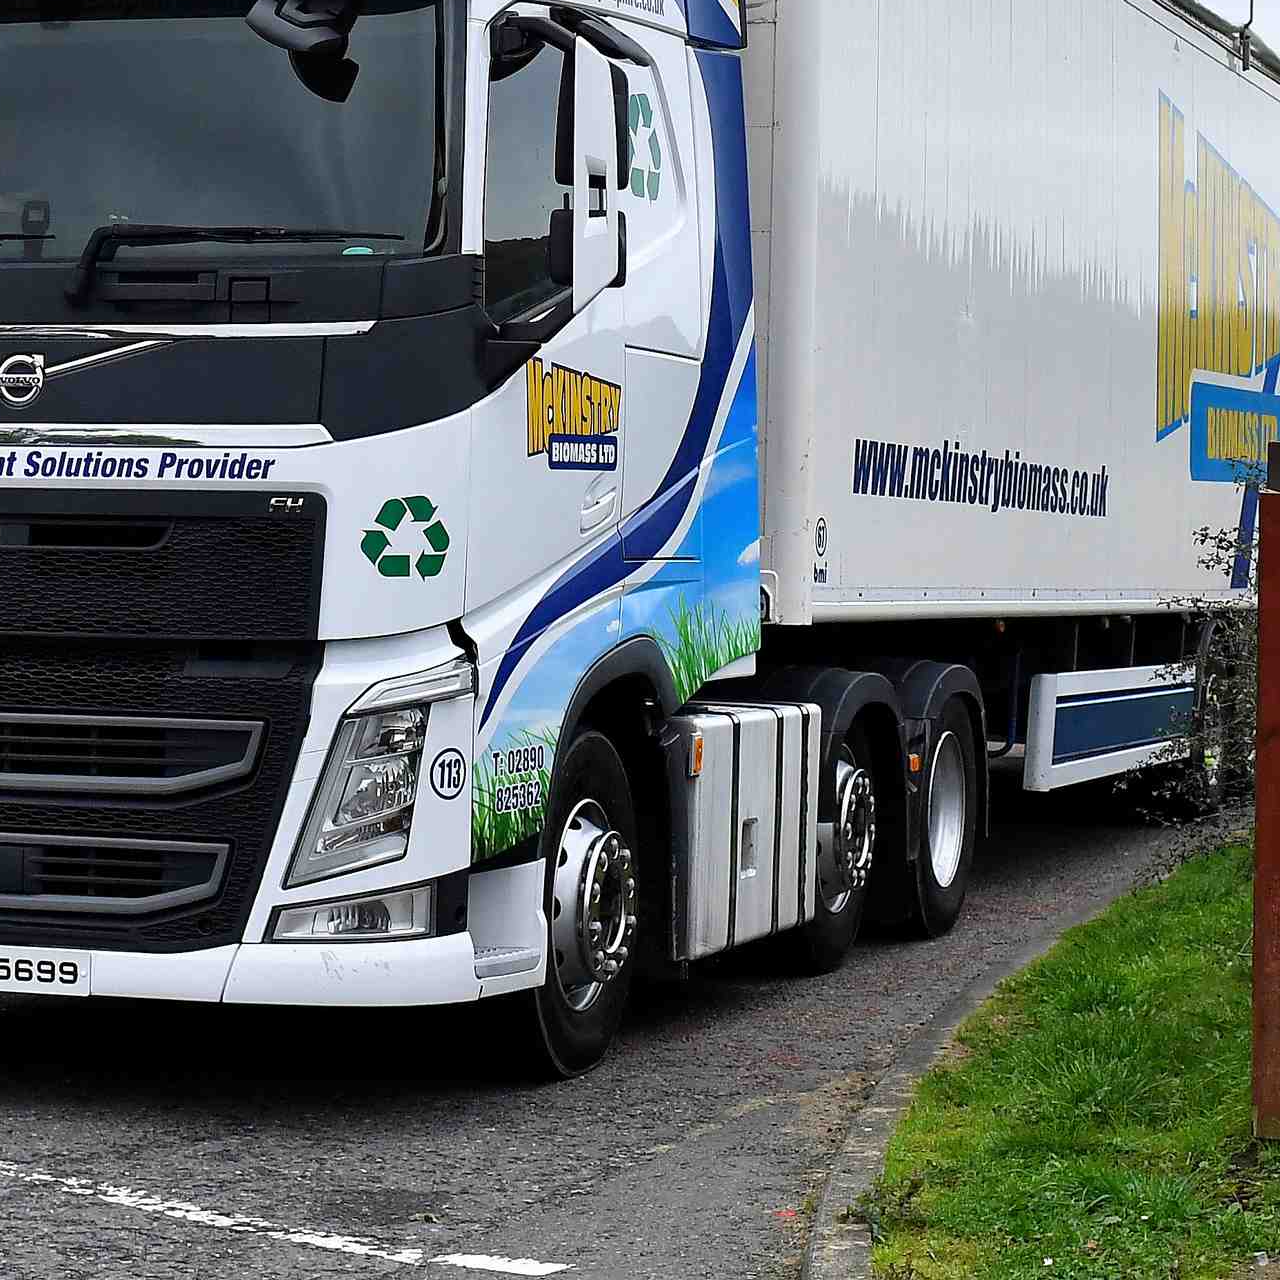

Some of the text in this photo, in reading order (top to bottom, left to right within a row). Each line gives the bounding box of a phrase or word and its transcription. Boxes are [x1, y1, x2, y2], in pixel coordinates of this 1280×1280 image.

[0, 375, 41, 386] VOLVO
[23, 450, 149, 479] Solutions
[157, 452, 276, 480] Provider
[551, 442, 616, 464] BIOMASS LTD
[852, 437, 1109, 518] www.mckinstrybiomass.co.uk
[439, 758, 462, 789] 113
[507, 745, 544, 775] 02890
[496, 782, 541, 812] 825362
